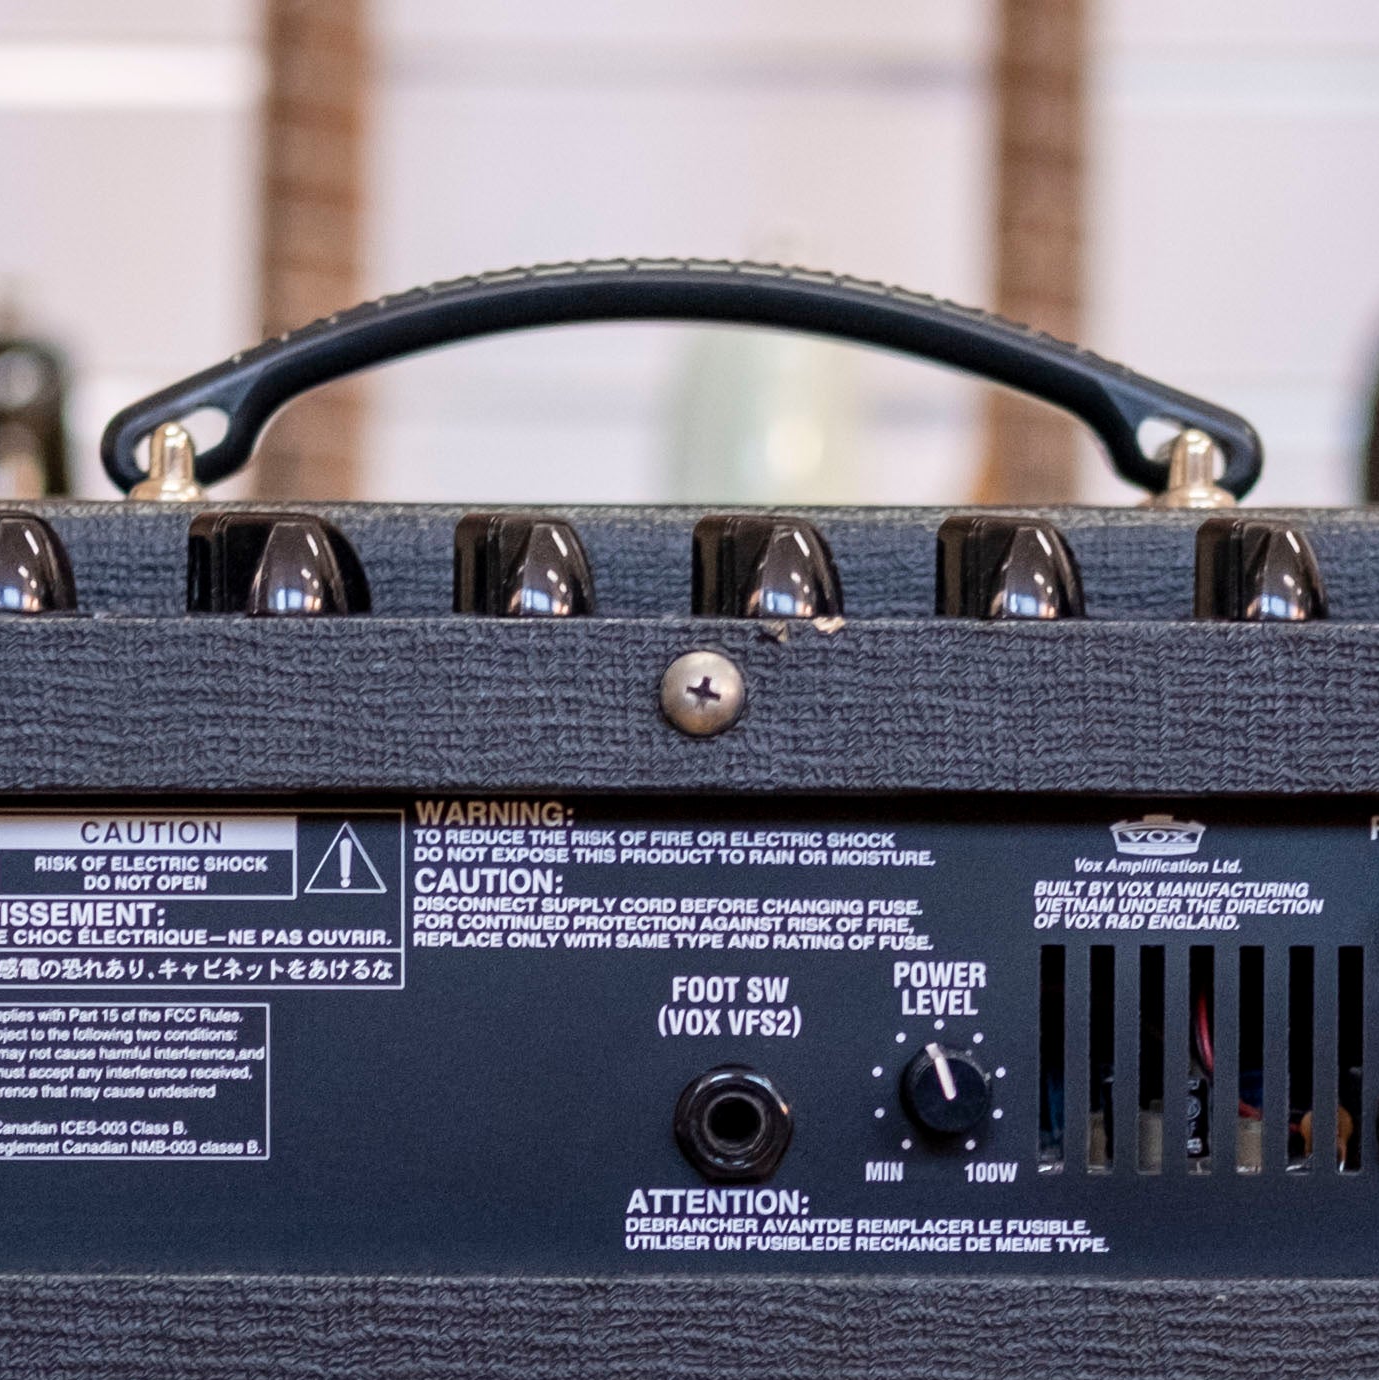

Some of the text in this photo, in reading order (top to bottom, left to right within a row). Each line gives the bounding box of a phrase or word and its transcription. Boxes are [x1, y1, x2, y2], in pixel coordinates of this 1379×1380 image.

[414, 800, 575, 827] WARNING:
[78, 819, 224, 846] CAUTION
[413, 829, 895, 849] TO REDUCE THE RISK OF FIRE OR ELECTRIC SHOCK
[33, 855, 269, 874] RISK OF ELECTRIC SHOCK
[413, 847, 444, 867] DO
[446, 847, 489, 867] NOT
[491, 847, 570, 867] EXPOSE
[572, 847, 617, 867] THIS
[620, 847, 716, 867] PRODUCT
[717, 847, 746, 867] TO
[748, 847, 796, 867] RAIN
[798, 847, 828, 867] OR
[1073, 858, 1243, 876] Vox Amplification Ltd.
[83, 873, 208, 892] DO NOT OPEN
[413, 868, 564, 894] CAUTION:
[1033, 881, 1310, 900] BUILT BY VOX MANUFACTURING
[413, 896, 923, 917] DISCONNECT SUPPLY CORD BEFORE CHANGING FUSE.
[1033, 897, 1325, 916] VIETNAM UNDER THE DIRECTION
[413, 914, 457, 935] FOR
[455, 914, 570, 935] CONTINUED
[570, 914, 699, 935] PROTECTION
[697, 914, 785, 935] AGAINST
[787, 914, 833, 935] RISK
[835, 914, 864, 935] OF
[1033, 914, 1241, 932] OF VOX R&D ENGLAND.
[12, 926, 73, 947] CHOC
[261, 926, 304, 947] PAS
[413, 931, 934, 951] REPLACE ONLY WITH SAME TYPE AND RATING OF FUSE.
[893, 961, 987, 988] POWER
[671, 976, 790, 1004] FOOT SW
[900, 989, 979, 1016] LEVEL
[657, 1005, 804, 1038] (VOX VFS2)
[30, 1026, 46, 1042] to
[47, 1026, 71, 1042] the
[135, 1026, 162, 1042] two
[163, 1026, 239, 1042] conditions:
[60, 1121, 128, 1137] ICES-003
[129, 1121, 170, 1137] Class
[864, 1161, 905, 1182] MIN
[963, 1161, 1018, 1183] 100W
[625, 1188, 810, 1216] ATTENTION:
[624, 1217, 761, 1237] DEBRANCHER
[856, 1217, 975, 1237] REMPLACER
[978, 1217, 1003, 1237] LE
[1006, 1217, 1092, 1237] FUSIBLE.
[624, 1234, 711, 1254] UTILISER
[713, 1234, 742, 1254] UN
[855, 1234, 962, 1254] RECHANGE
[965, 1234, 992, 1254] DE
[995, 1234, 1054, 1254] MEME
[1055, 1234, 1111, 1254] TYPE.
